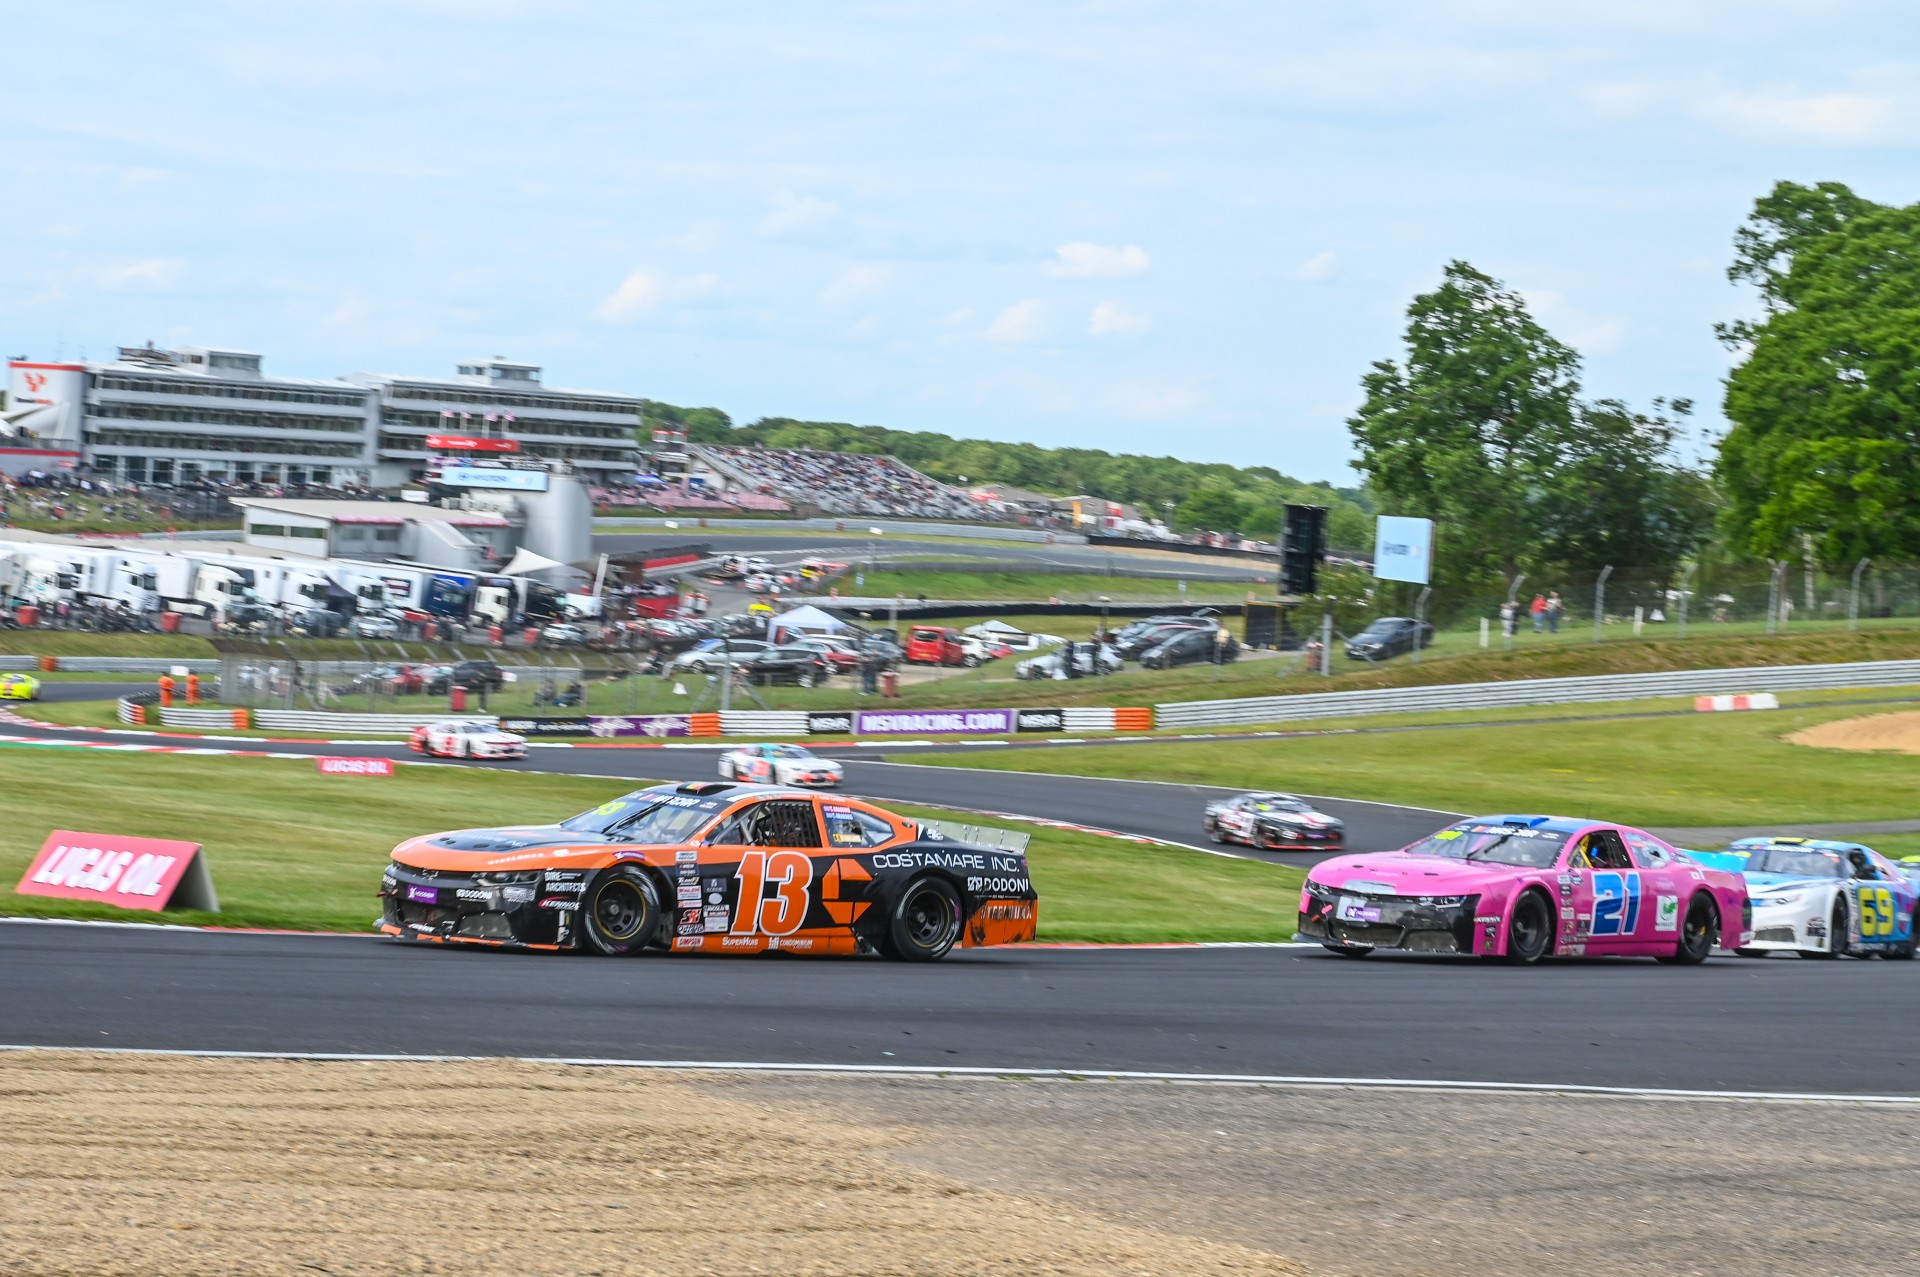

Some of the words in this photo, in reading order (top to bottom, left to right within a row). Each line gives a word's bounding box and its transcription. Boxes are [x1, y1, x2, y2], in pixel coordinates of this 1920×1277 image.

[322, 759, 365, 773] LUCAS
[366, 761, 389, 774] OIL
[31, 845, 135, 892] LUCAS
[116, 852, 177, 896] OIL
[872, 853, 985, 868] COSTAMARE
[991, 856, 1020, 873] INC.
[984, 877, 1029, 892] DODONI
[730, 851, 813, 936] 13
[1591, 871, 1641, 936] 21
[1858, 887, 1893, 936] 69
